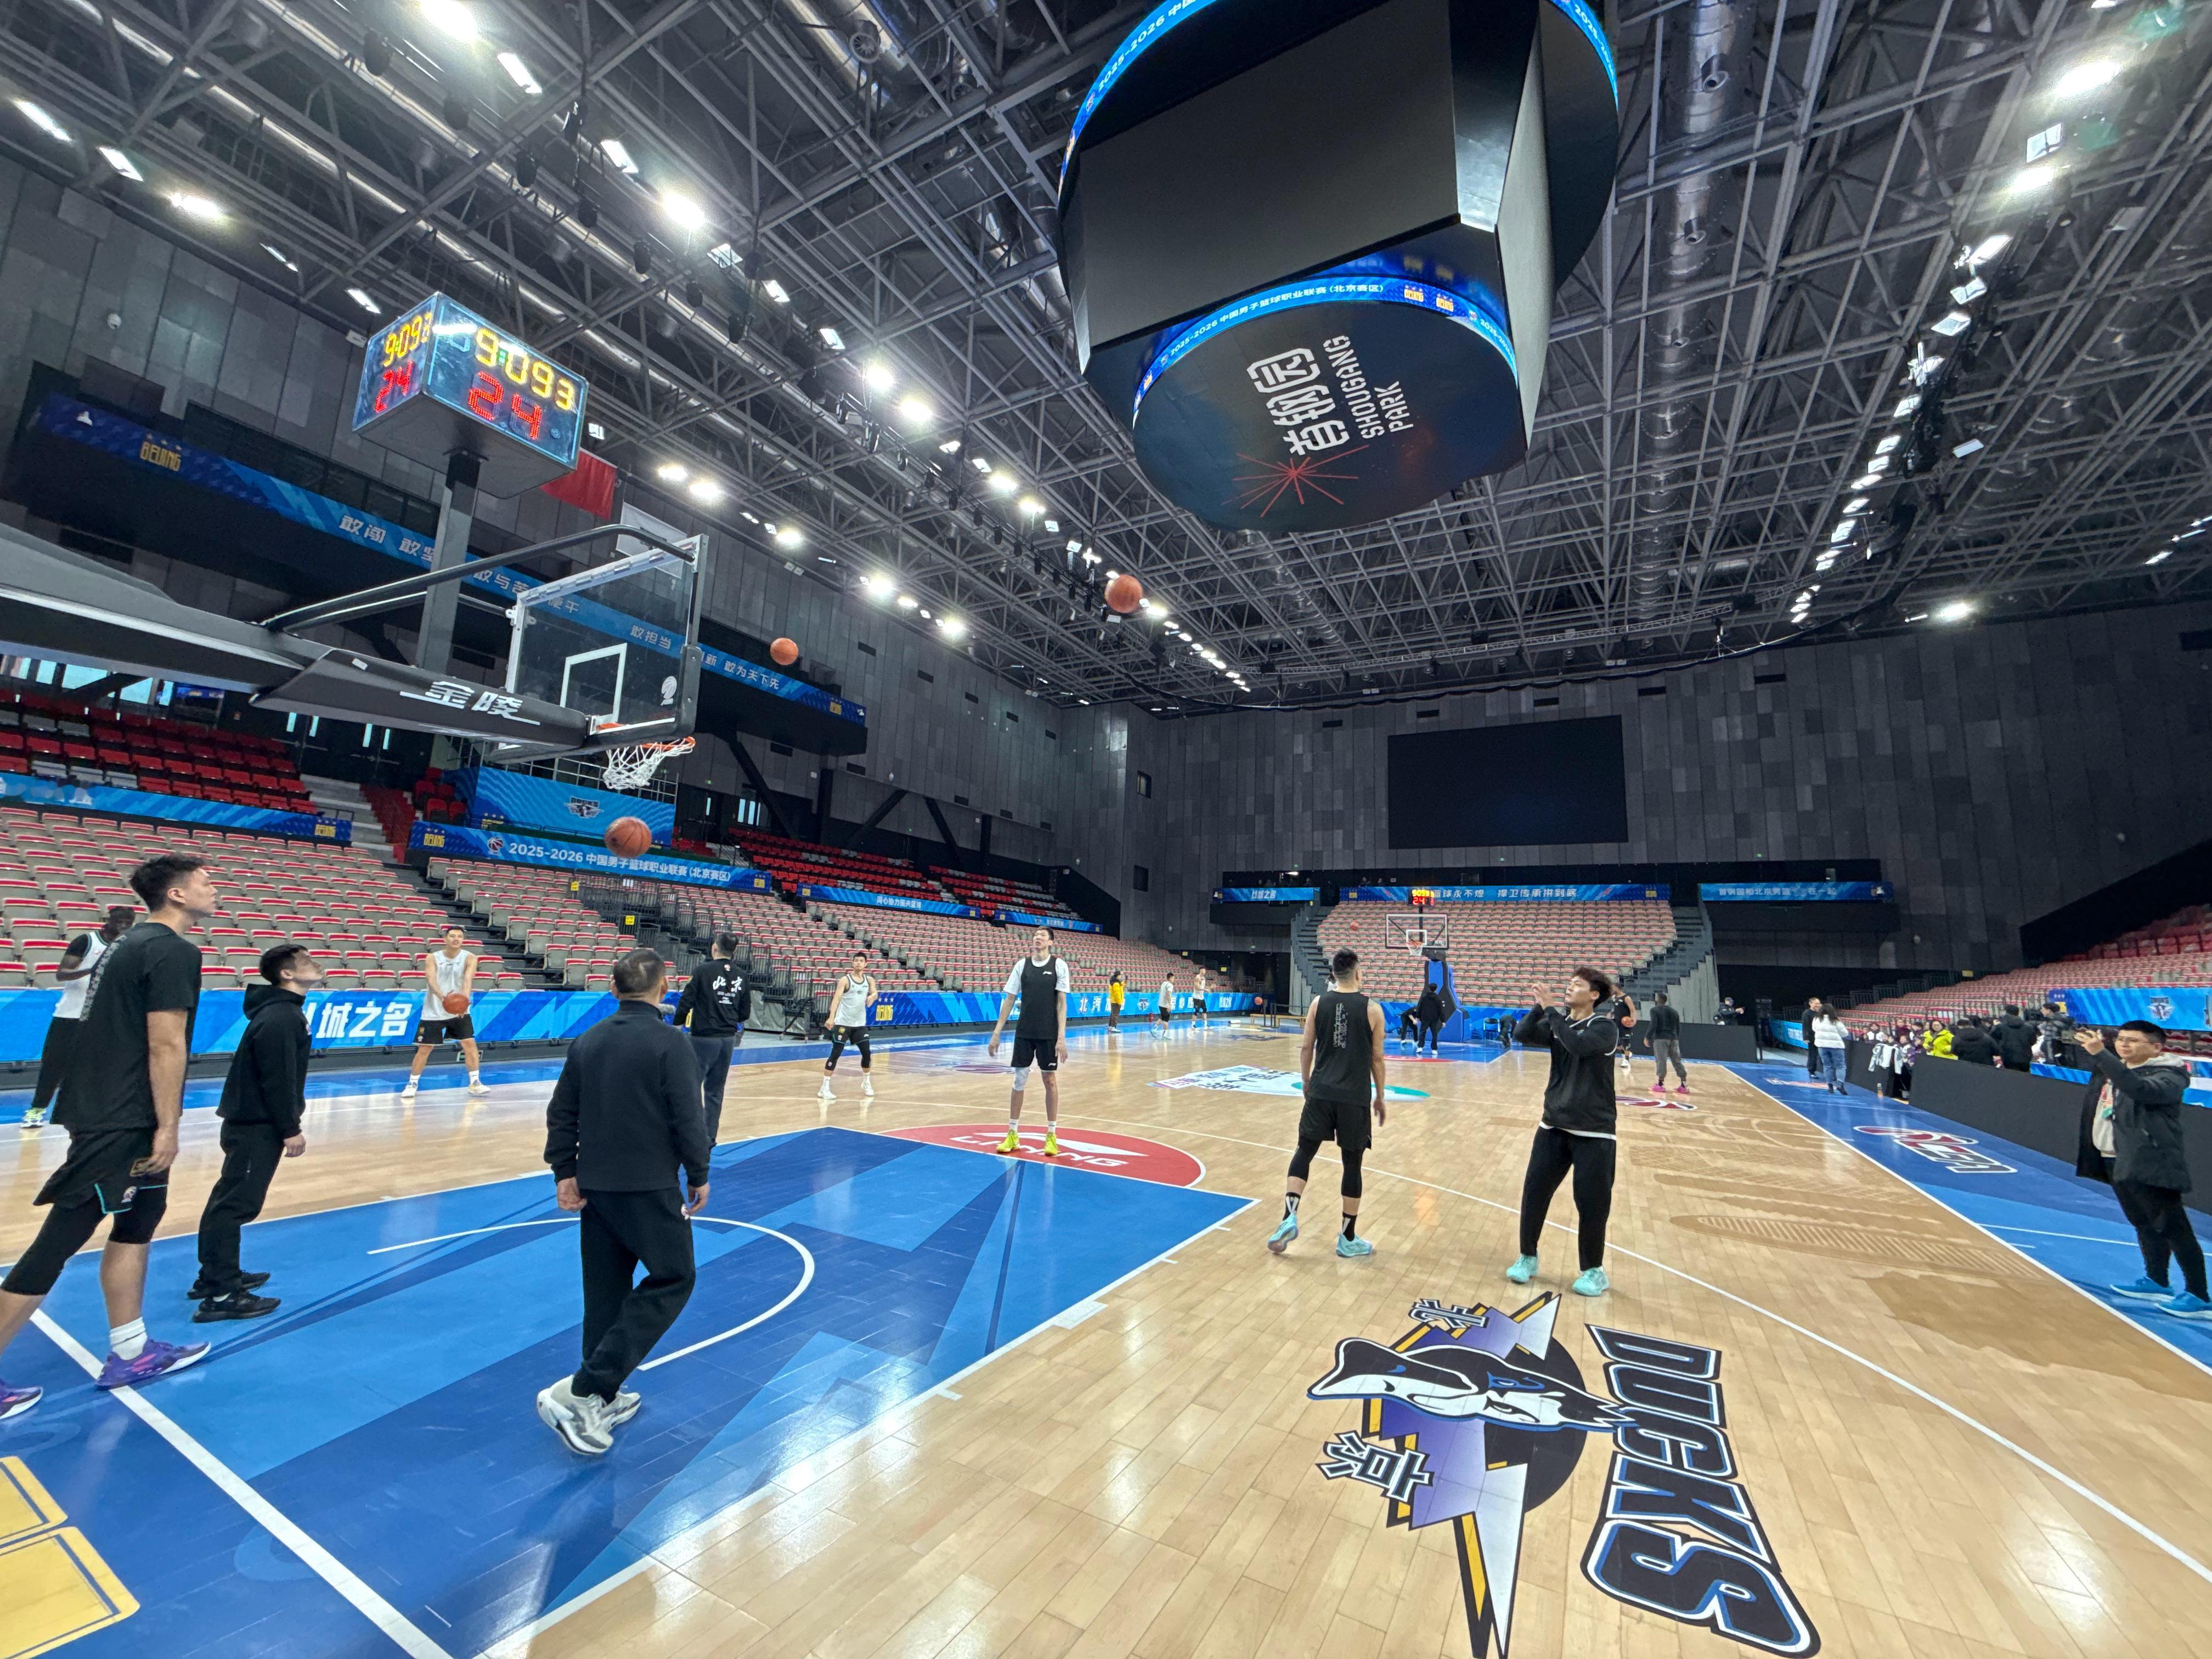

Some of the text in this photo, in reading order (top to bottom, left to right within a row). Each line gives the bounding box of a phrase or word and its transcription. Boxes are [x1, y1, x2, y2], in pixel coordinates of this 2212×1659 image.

[1099, 15, 1165, 92] 2025-2026
[1171, 320, 1218, 356] 2025-2026
[375, 360, 413, 413] 24
[469, 371, 542, 440] 24
[1246, 348, 1350, 450] 首钢园
[1323, 335, 1385, 439] SHOUGANG
[1374, 381, 1414, 432] PARK
[338, 515, 386, 544] 敢闯
[630, 624, 672, 650] 敢担当
[723, 660, 780, 690] 敢为天下先
[400, 681, 540, 726] 金陵
[509, 843, 584, 863] 2025-2026
[1497, 888, 1577, 898] 捍卫传承拼到底
[1719, 887, 1837, 897] 首钢园和北京男篮在一起
[713, 975, 743, 993] 北京
[1581, 1323, 1822, 1658] DUCKS
